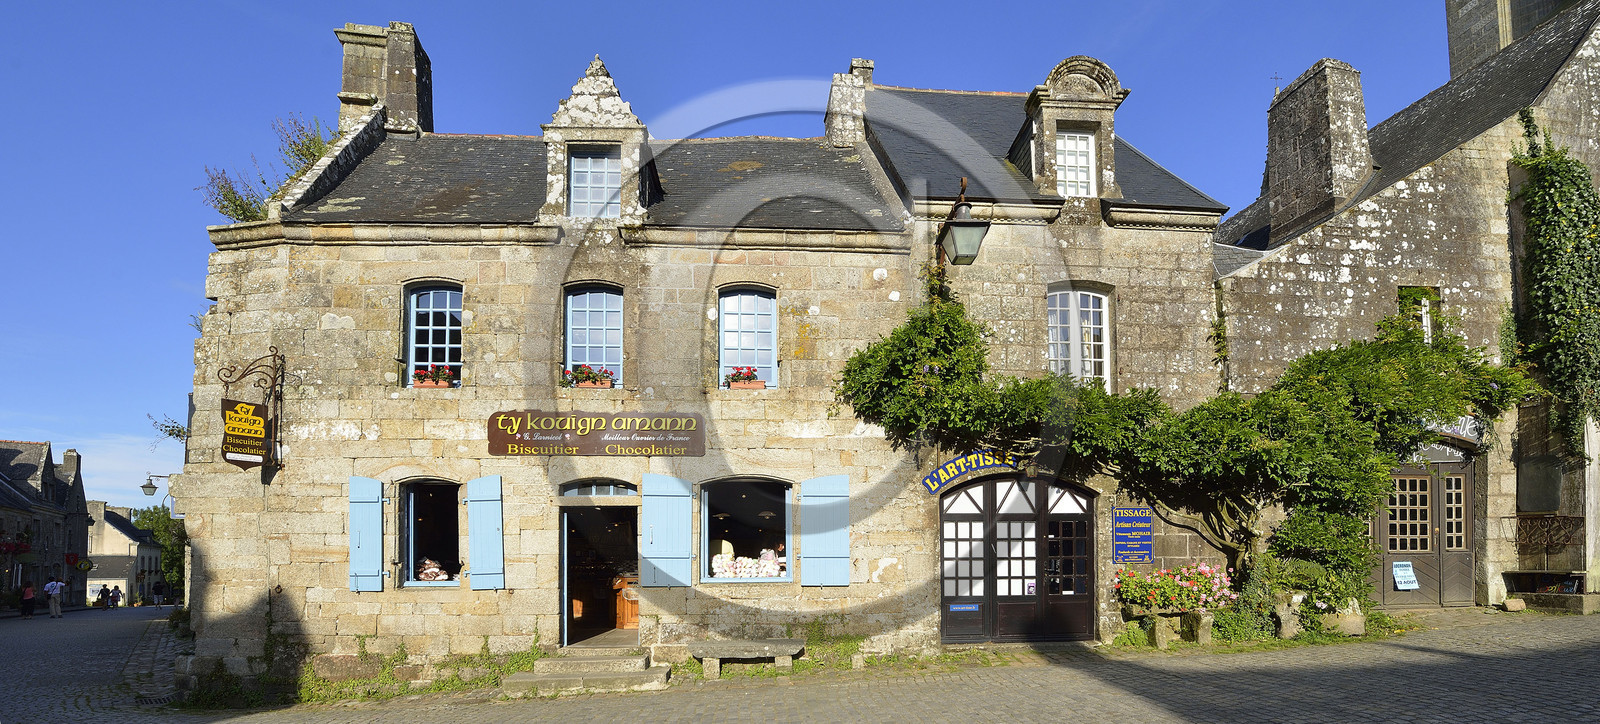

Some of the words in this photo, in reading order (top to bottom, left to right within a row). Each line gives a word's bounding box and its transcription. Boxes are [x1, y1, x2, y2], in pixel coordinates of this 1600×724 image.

[527, 413, 606, 435] kouign
[611, 417, 697, 431] amann
[228, 426, 262, 435] amann
[226, 436, 262, 446] Biscuitier
[601, 433, 630, 441] Meilleur
[631, 433, 655, 441] Ouvrier
[656, 433, 664, 441] de
[665, 433, 691, 441] France
[222, 444, 267, 455] Chocolatier
[507, 443, 580, 455] Biscuitier
[605, 444, 687, 455] Chocolatier
[924, 450, 1015, 492] L'ART-TISSE
[1115, 509, 1152, 517] TISSAGE
